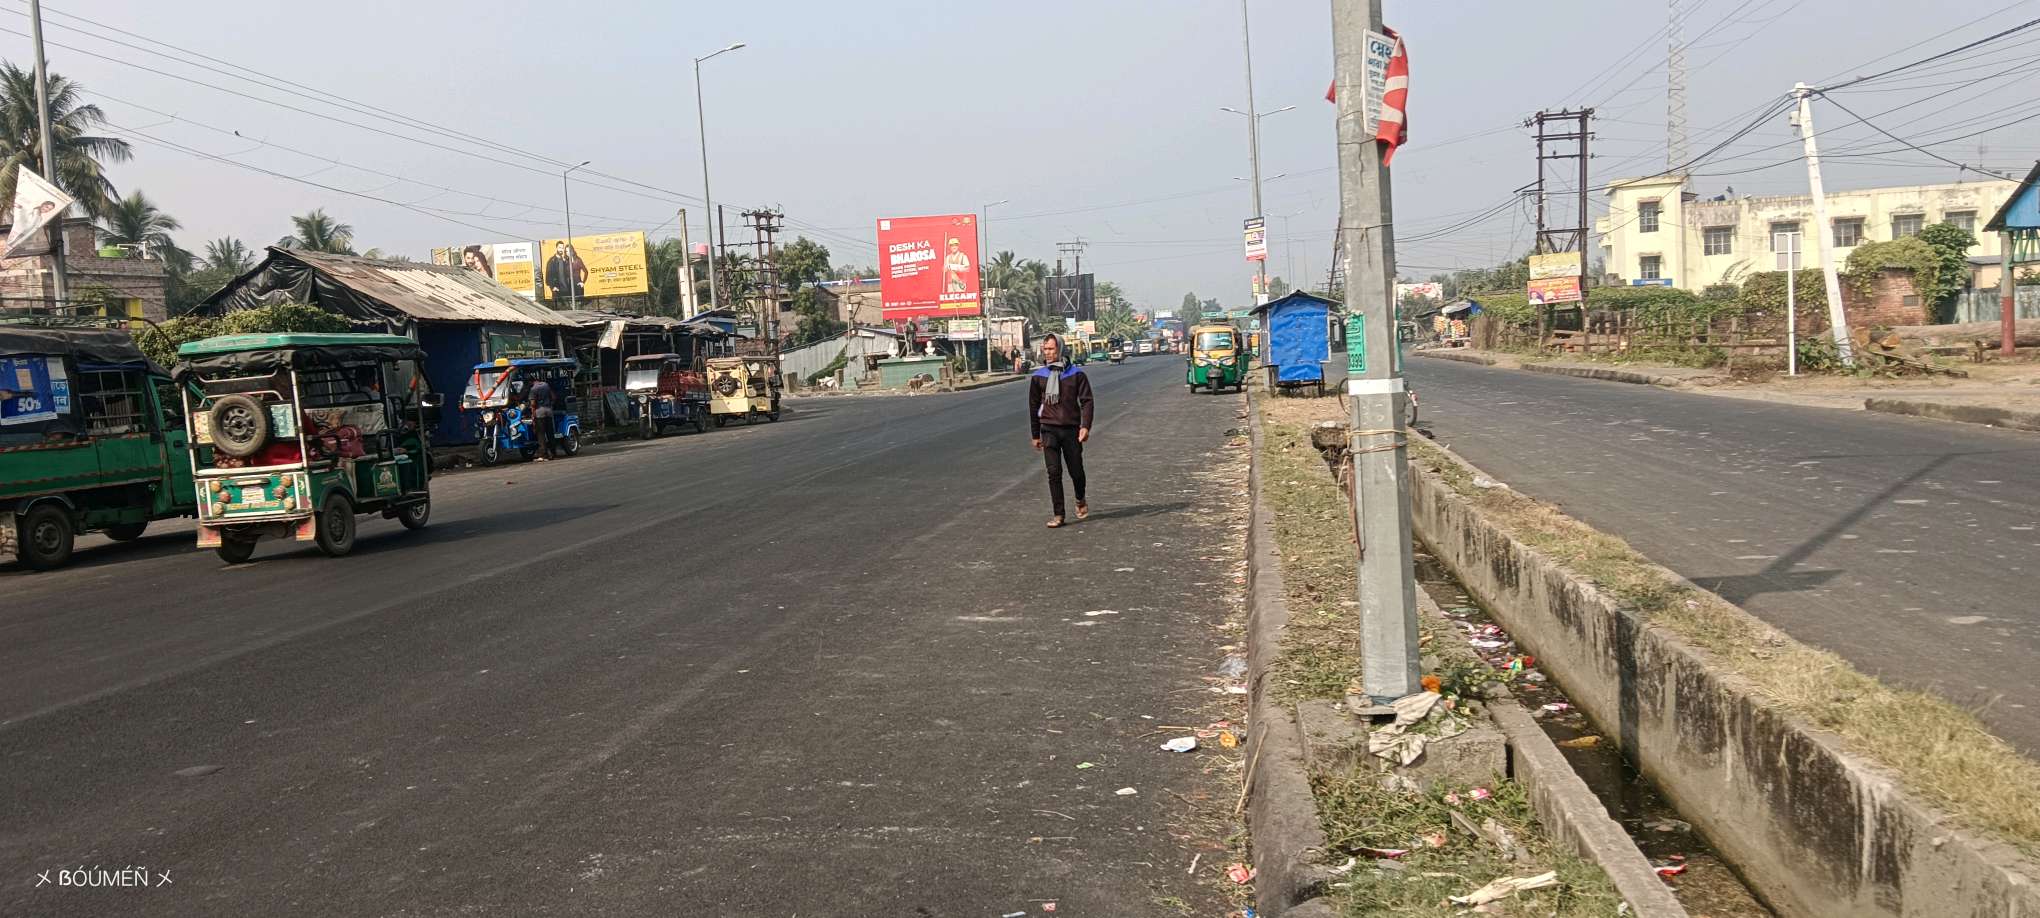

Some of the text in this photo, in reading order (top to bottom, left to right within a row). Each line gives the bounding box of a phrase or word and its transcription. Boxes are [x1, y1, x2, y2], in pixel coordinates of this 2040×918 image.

[889, 240, 930, 253] DESH KA
[890, 248, 936, 265] BHAROSA
[590, 264, 644, 274] SHYAM STEEL
[17, 396, 42, 412] 50%
